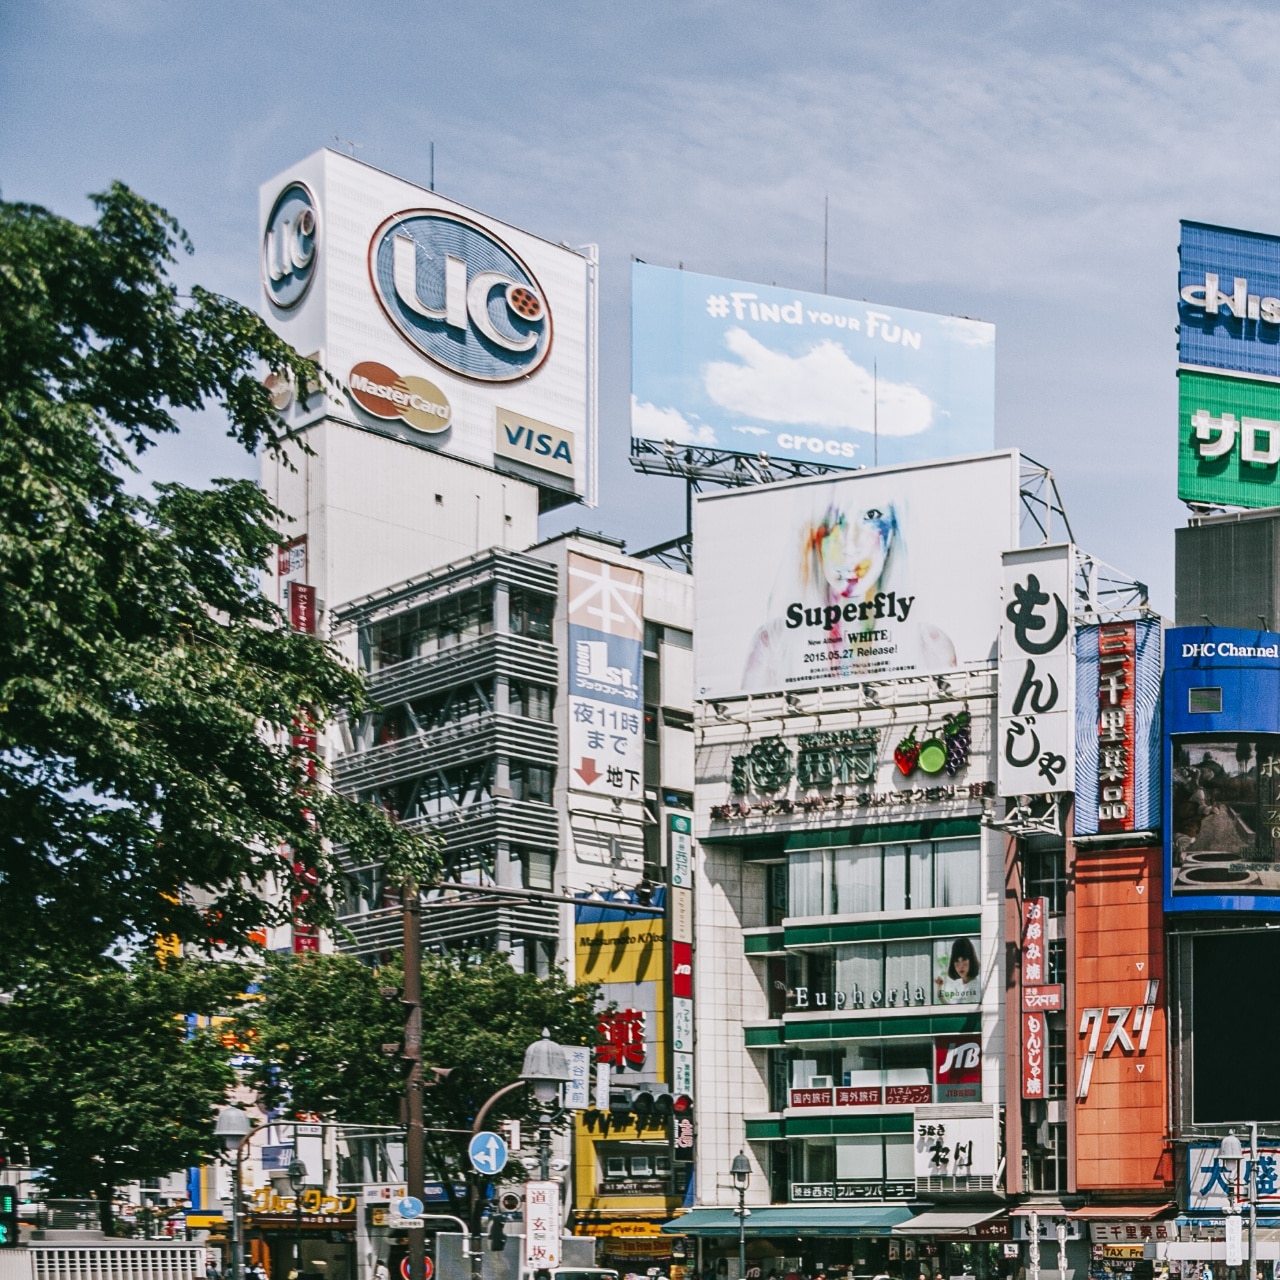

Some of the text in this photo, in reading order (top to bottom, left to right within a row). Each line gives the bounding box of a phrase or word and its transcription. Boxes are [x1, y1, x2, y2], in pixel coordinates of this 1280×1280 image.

[351, 373, 451, 420] MasterCard
[503, 423, 573, 466] VISA
[568, 563, 643, 633] 本
[785, 591, 915, 631] Superfly
[803, 644, 898, 663] 2015.05.27 Release!
[1181, 641, 1279, 659] DHC Channel
[1006, 574, 1067, 785] もんじゃ
[573, 702, 639, 735] 夜11時
[1099, 627, 1129, 821] 三千里薬品
[587, 730, 628, 756] まで
[606, 764, 641, 792] 地下
[579, 935, 635, 947] Matsumoto
[1026, 903, 1042, 980] お好み焼
[794, 981, 926, 1011] Euphoria
[939, 988, 977, 999] Euphoria
[1077, 980, 1159, 1098] クスリ
[939, 1041, 981, 1075] JTB
[1026, 1015, 1042, 1095] もんじゃ焼
[793, 1091, 831, 1104] 国内旅行
[839, 1090, 879, 1102] 海外旅行
[889, 1086, 927, 1095] ハネムーン
[918, 1123, 946, 1137] うなぎ
[531, 1190, 547, 1260] 道玄坂
[1095, 1225, 1168, 1241] 三千里薬品
[1104, 1248, 1123, 1258] TAX
